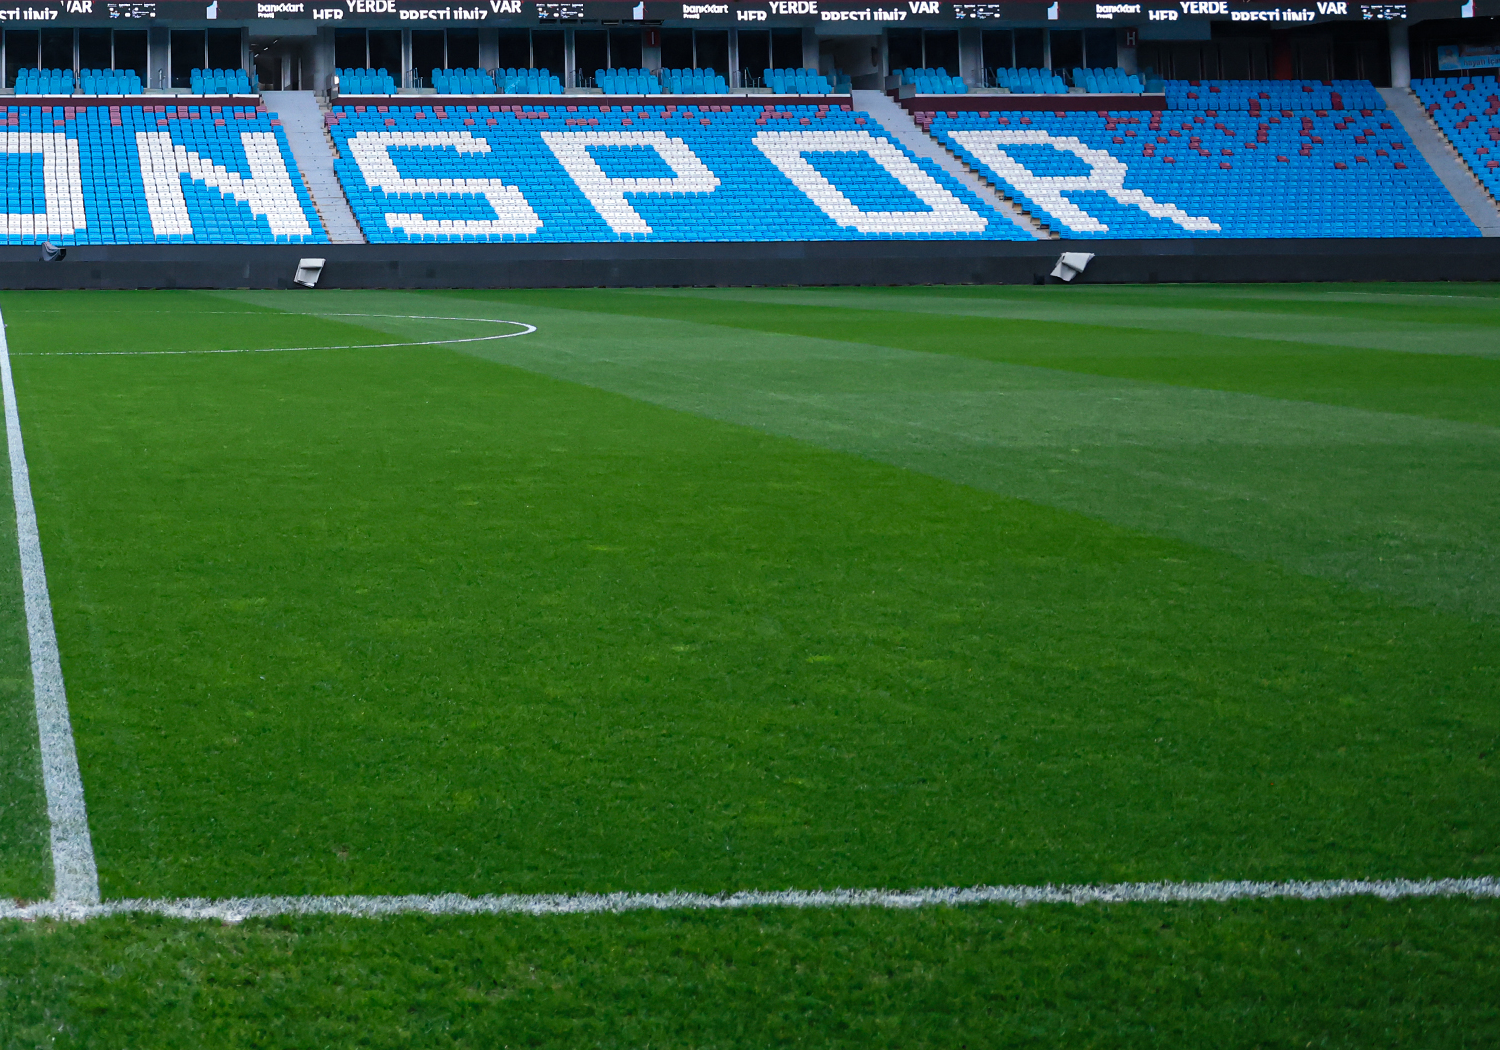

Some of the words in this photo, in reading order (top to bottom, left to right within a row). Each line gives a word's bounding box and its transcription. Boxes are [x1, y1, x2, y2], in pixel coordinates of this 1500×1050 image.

[345, 0, 397, 13] YERDE
[490, 0, 522, 13] VAR
[769, 1, 819, 14] YERDE
[908, 1, 940, 14] VAR
[1180, 1, 1229, 14] YERDE
[1316, 2, 1348, 15] VAR
[1126, 32, 1136, 45] H
